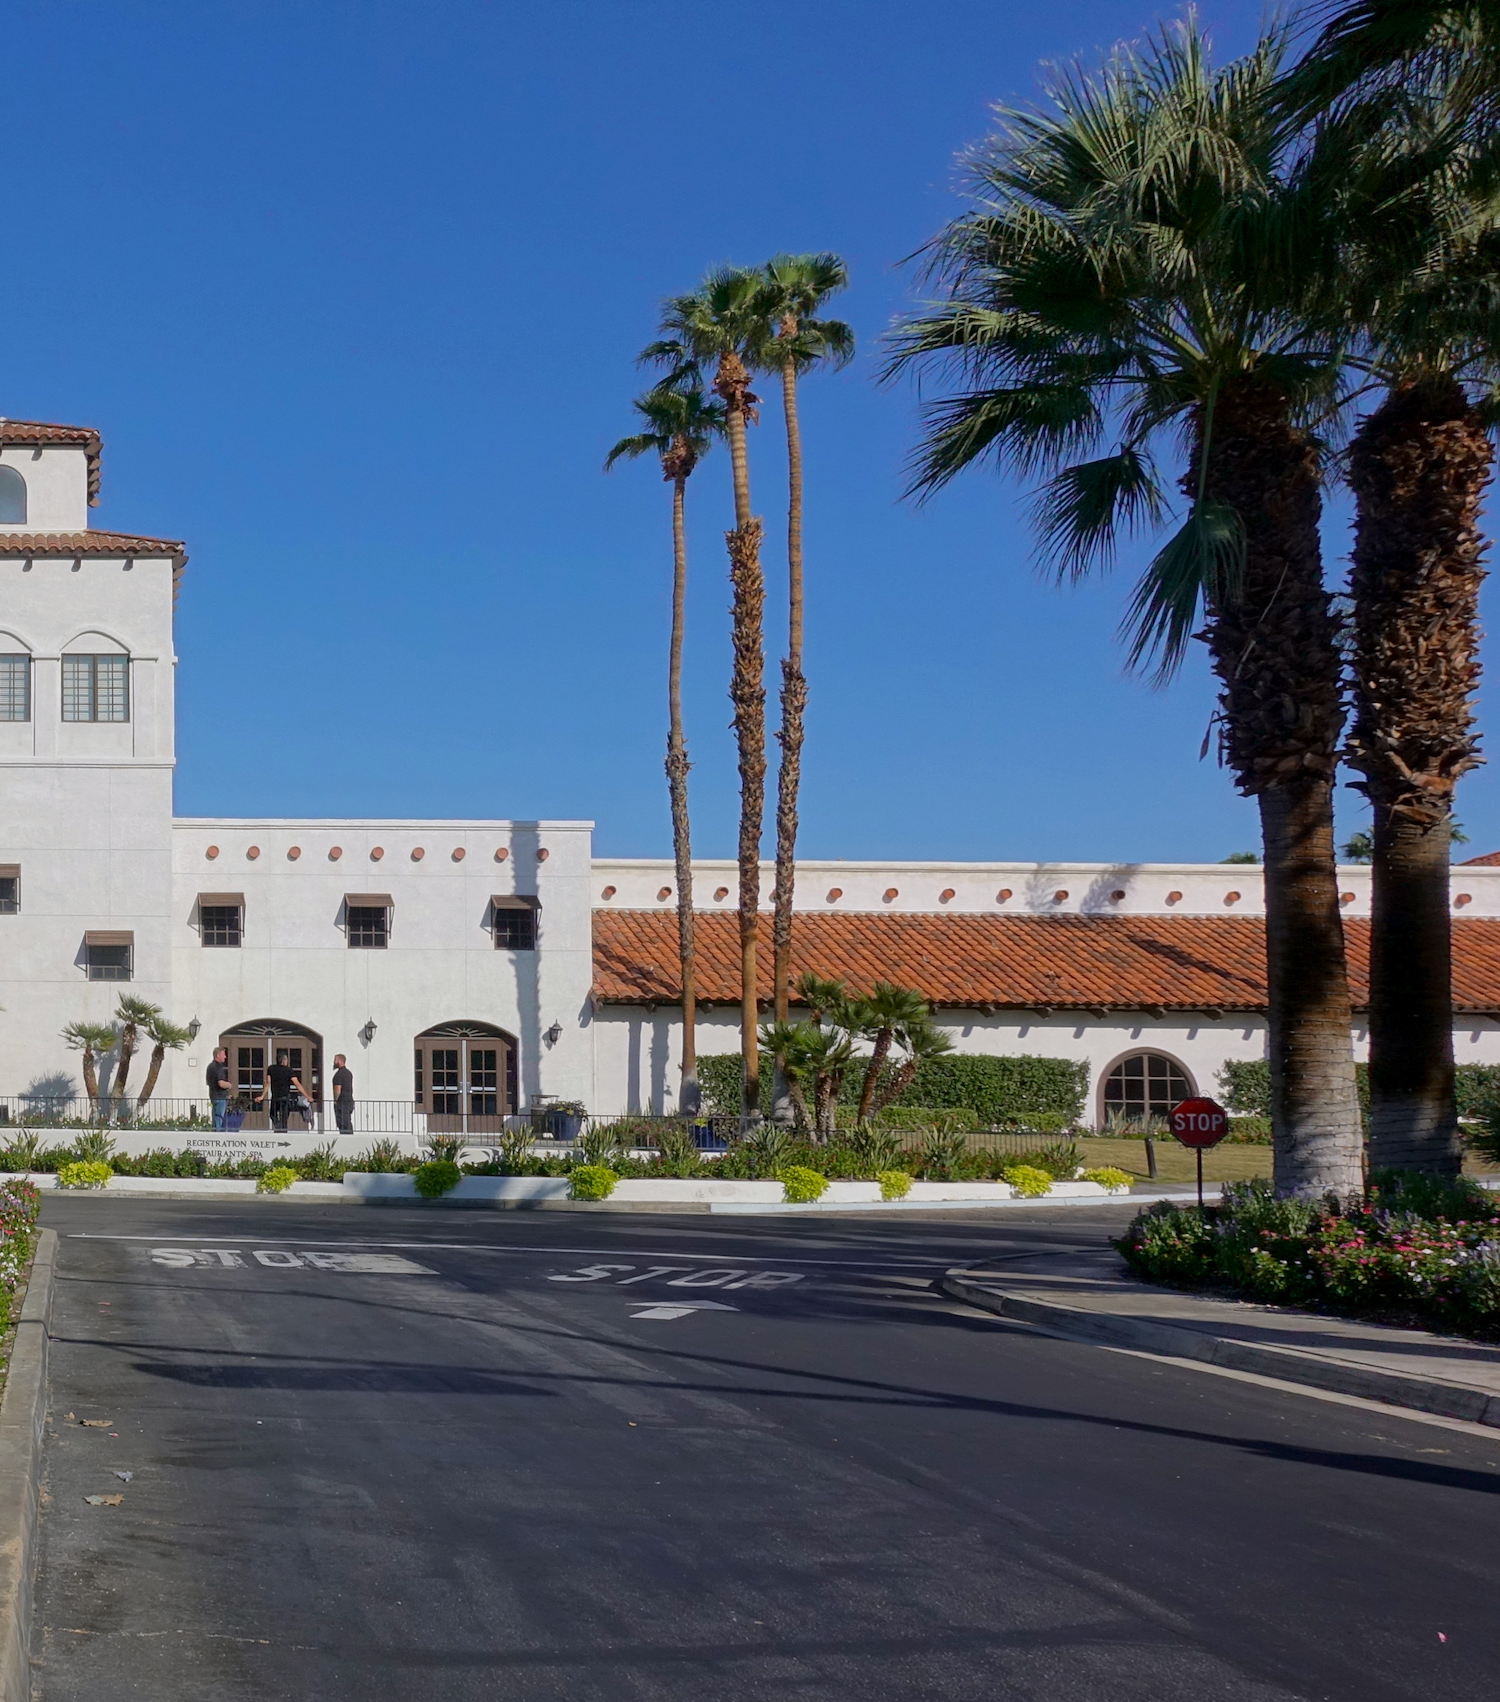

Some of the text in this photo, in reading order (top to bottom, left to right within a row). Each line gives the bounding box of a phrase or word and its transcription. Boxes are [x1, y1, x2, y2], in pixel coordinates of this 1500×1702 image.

[1174, 1113, 1223, 1131] STOP
[186, 1139, 276, 1149] REGISTRATION VALET
[189, 1149, 263, 1159] STAURANTS SPA
[151, 1247, 353, 1272] STOP
[547, 1264, 806, 1291] STOP
